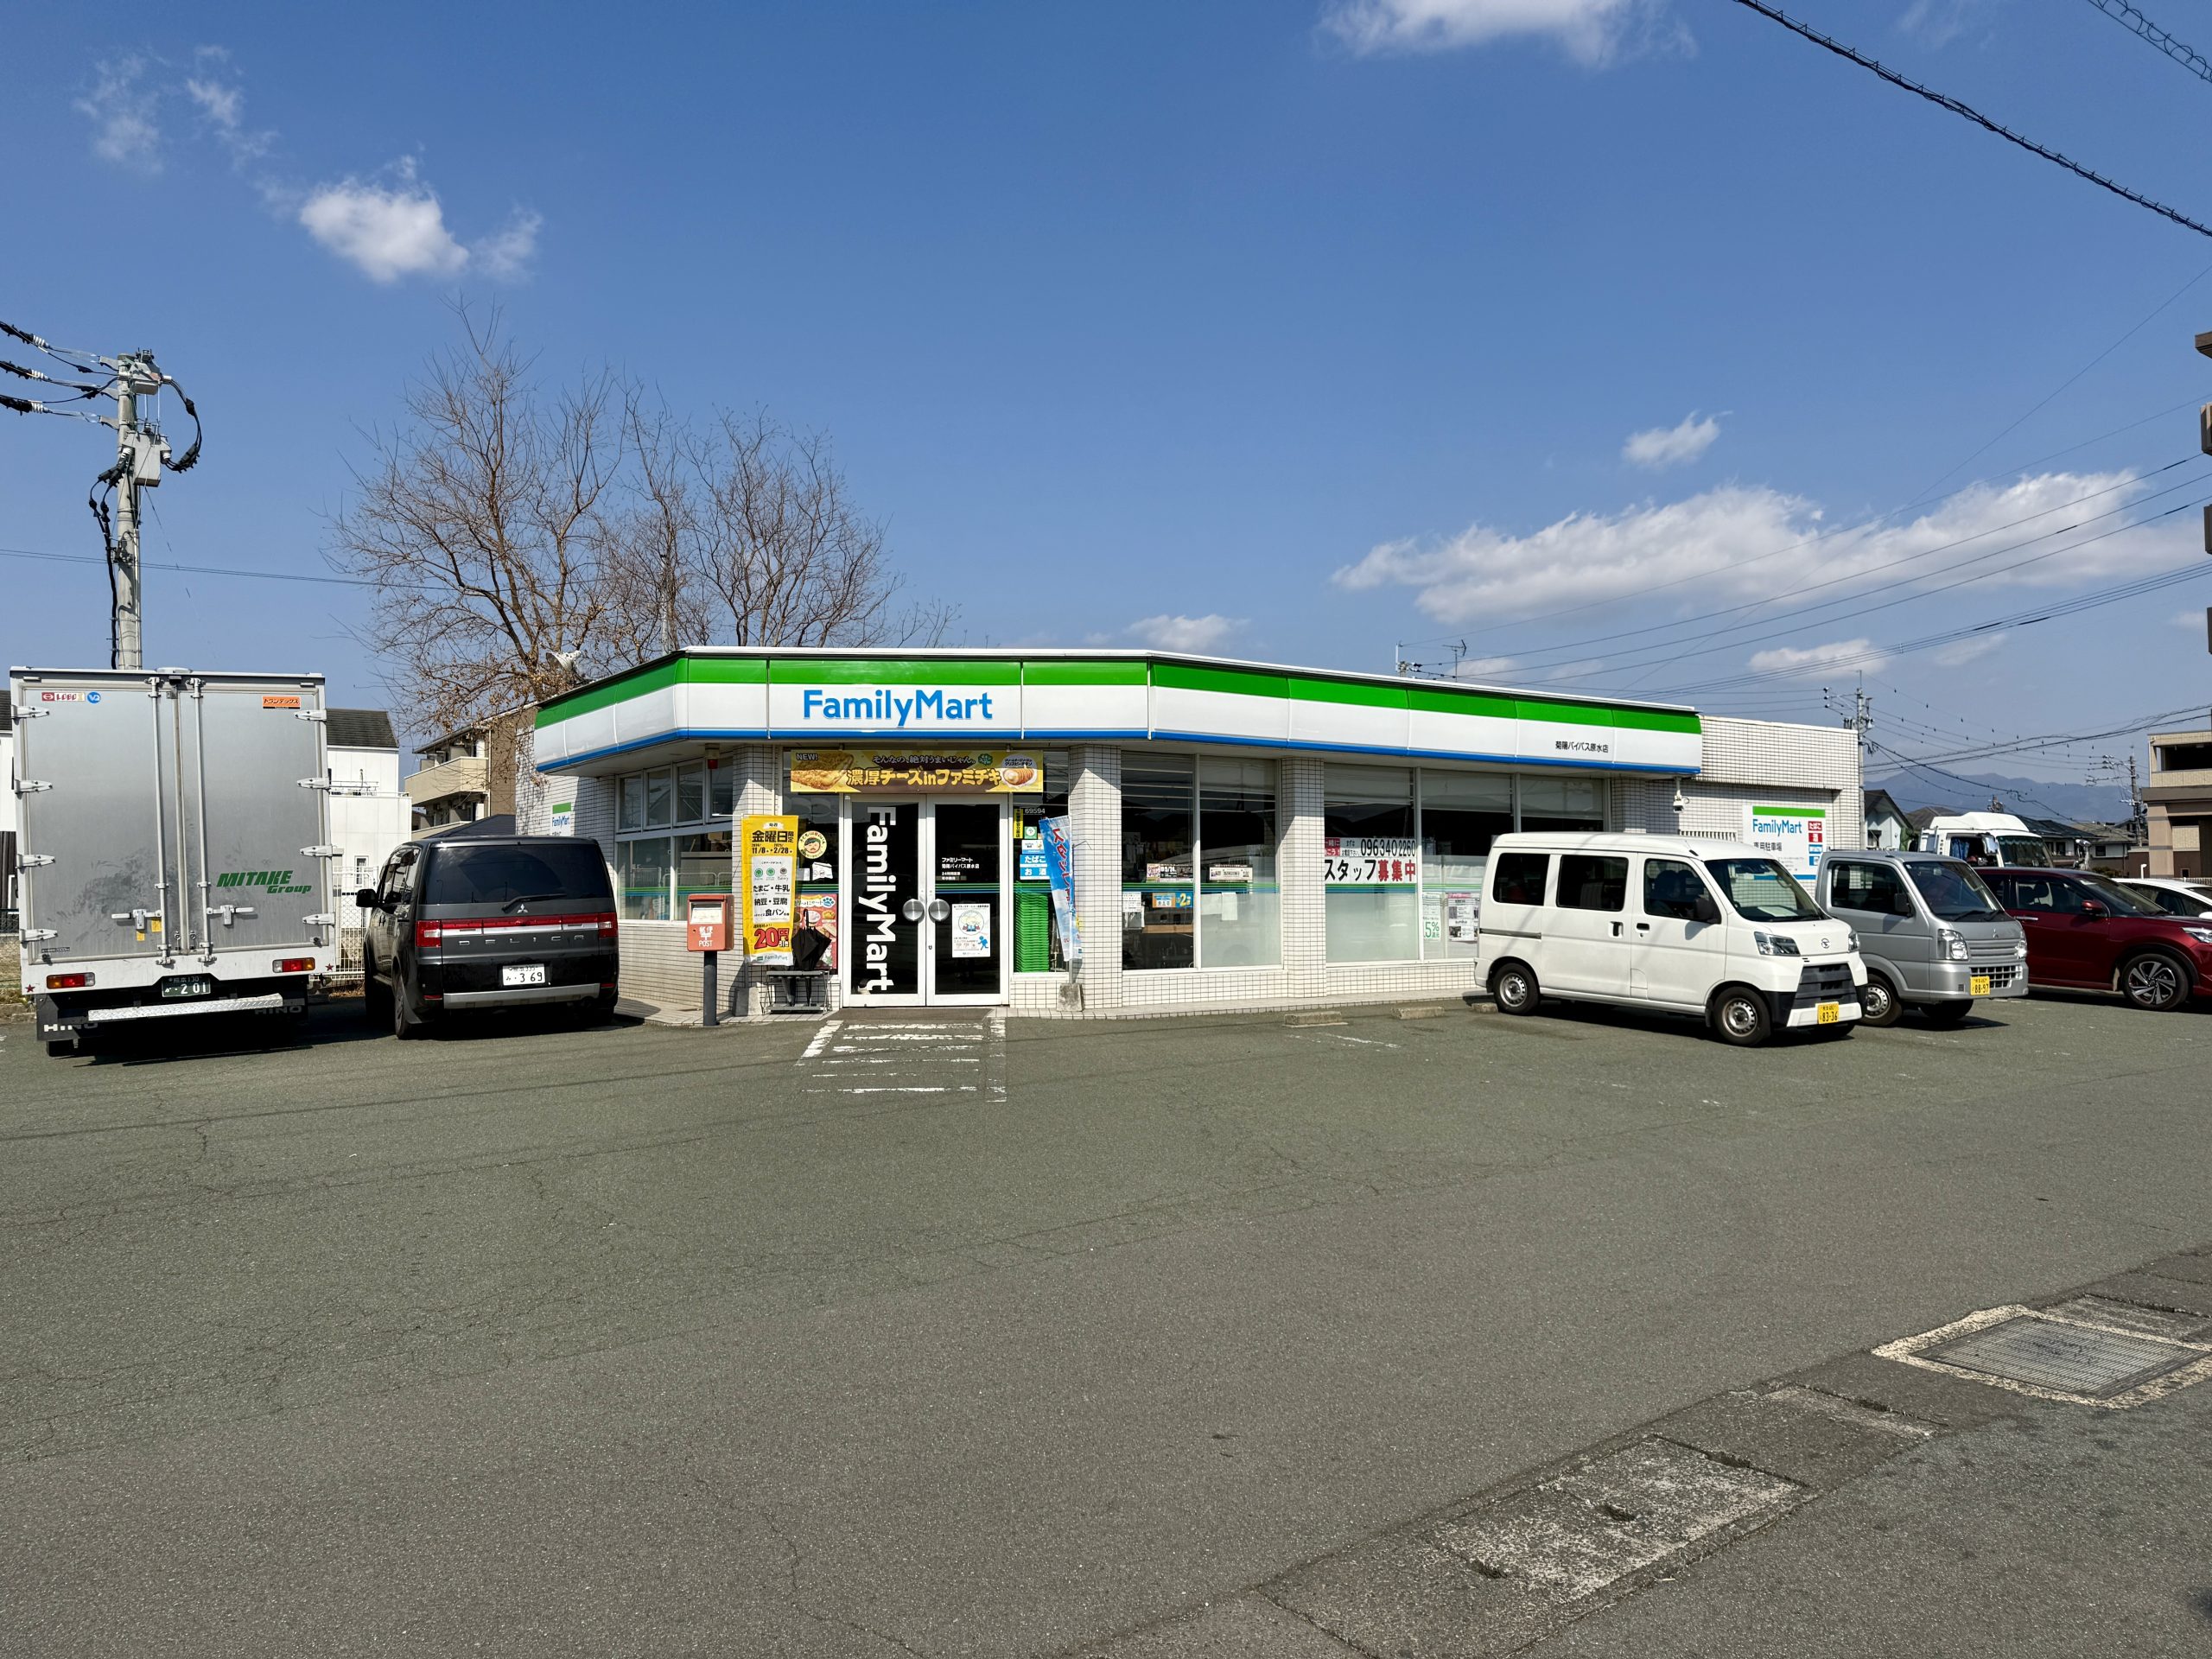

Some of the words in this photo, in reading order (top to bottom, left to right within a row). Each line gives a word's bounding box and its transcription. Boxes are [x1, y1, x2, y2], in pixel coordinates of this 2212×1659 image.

[804, 690, 993, 728] FamilyMart
[1554, 741, 1609, 753] 菊陽バイパス原水店
[796, 753, 819, 761] NEW!
[873, 754, 976, 765] そんなの、絶対うまいじゃん。
[847, 766, 1001, 785] 濃厚チーズinファミチキ
[1752, 819, 1802, 836] FamilyMart
[216, 870, 294, 887] MITAKE
[1325, 859, 1416, 882] スタッフ募集中
[267, 885, 312, 894] Group
[858, 806, 897, 991] FamilyMart
[458, 935, 584, 945] DELICA
